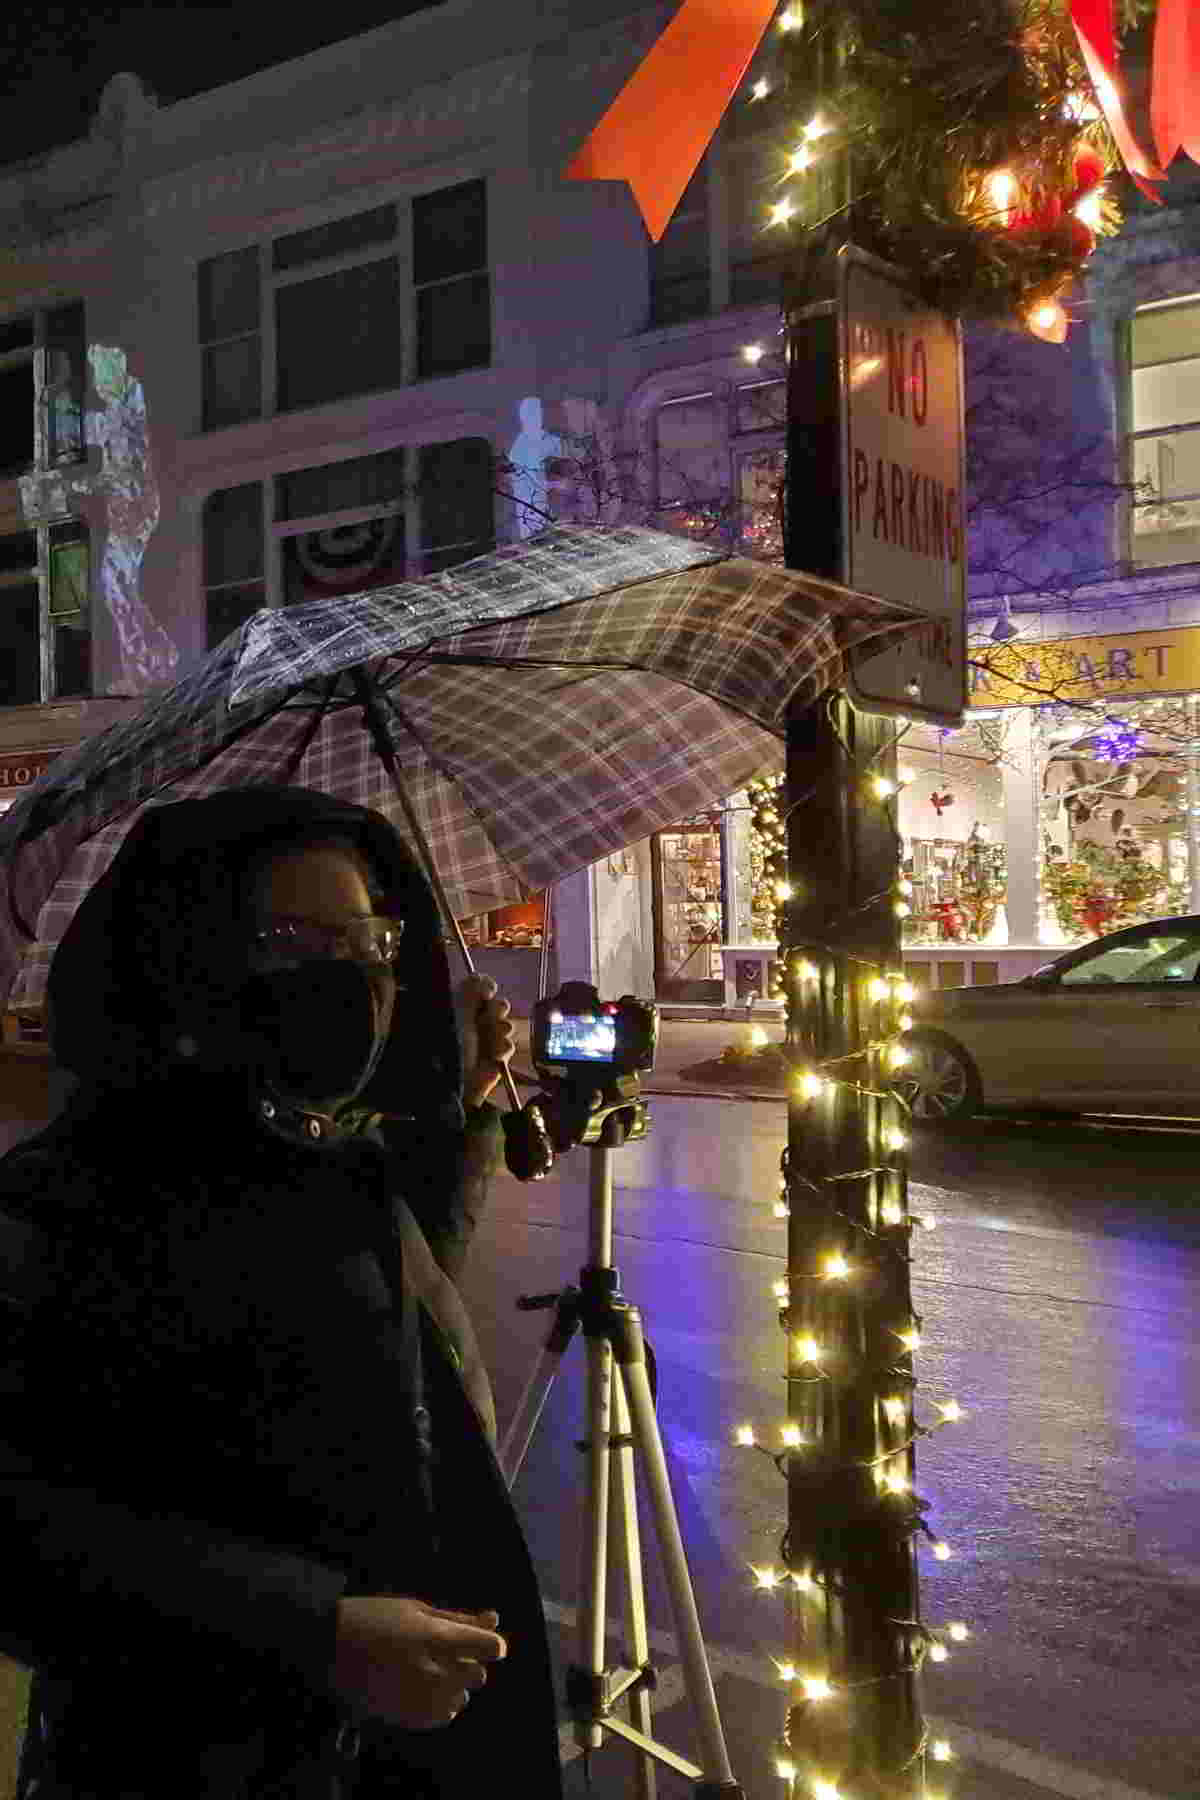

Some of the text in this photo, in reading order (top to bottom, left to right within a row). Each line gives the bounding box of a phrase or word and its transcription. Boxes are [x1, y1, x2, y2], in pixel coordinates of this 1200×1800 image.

[886, 328, 927, 427] NO
[854, 448, 959, 565] PARKING
[1074, 645, 1176, 686] ART
